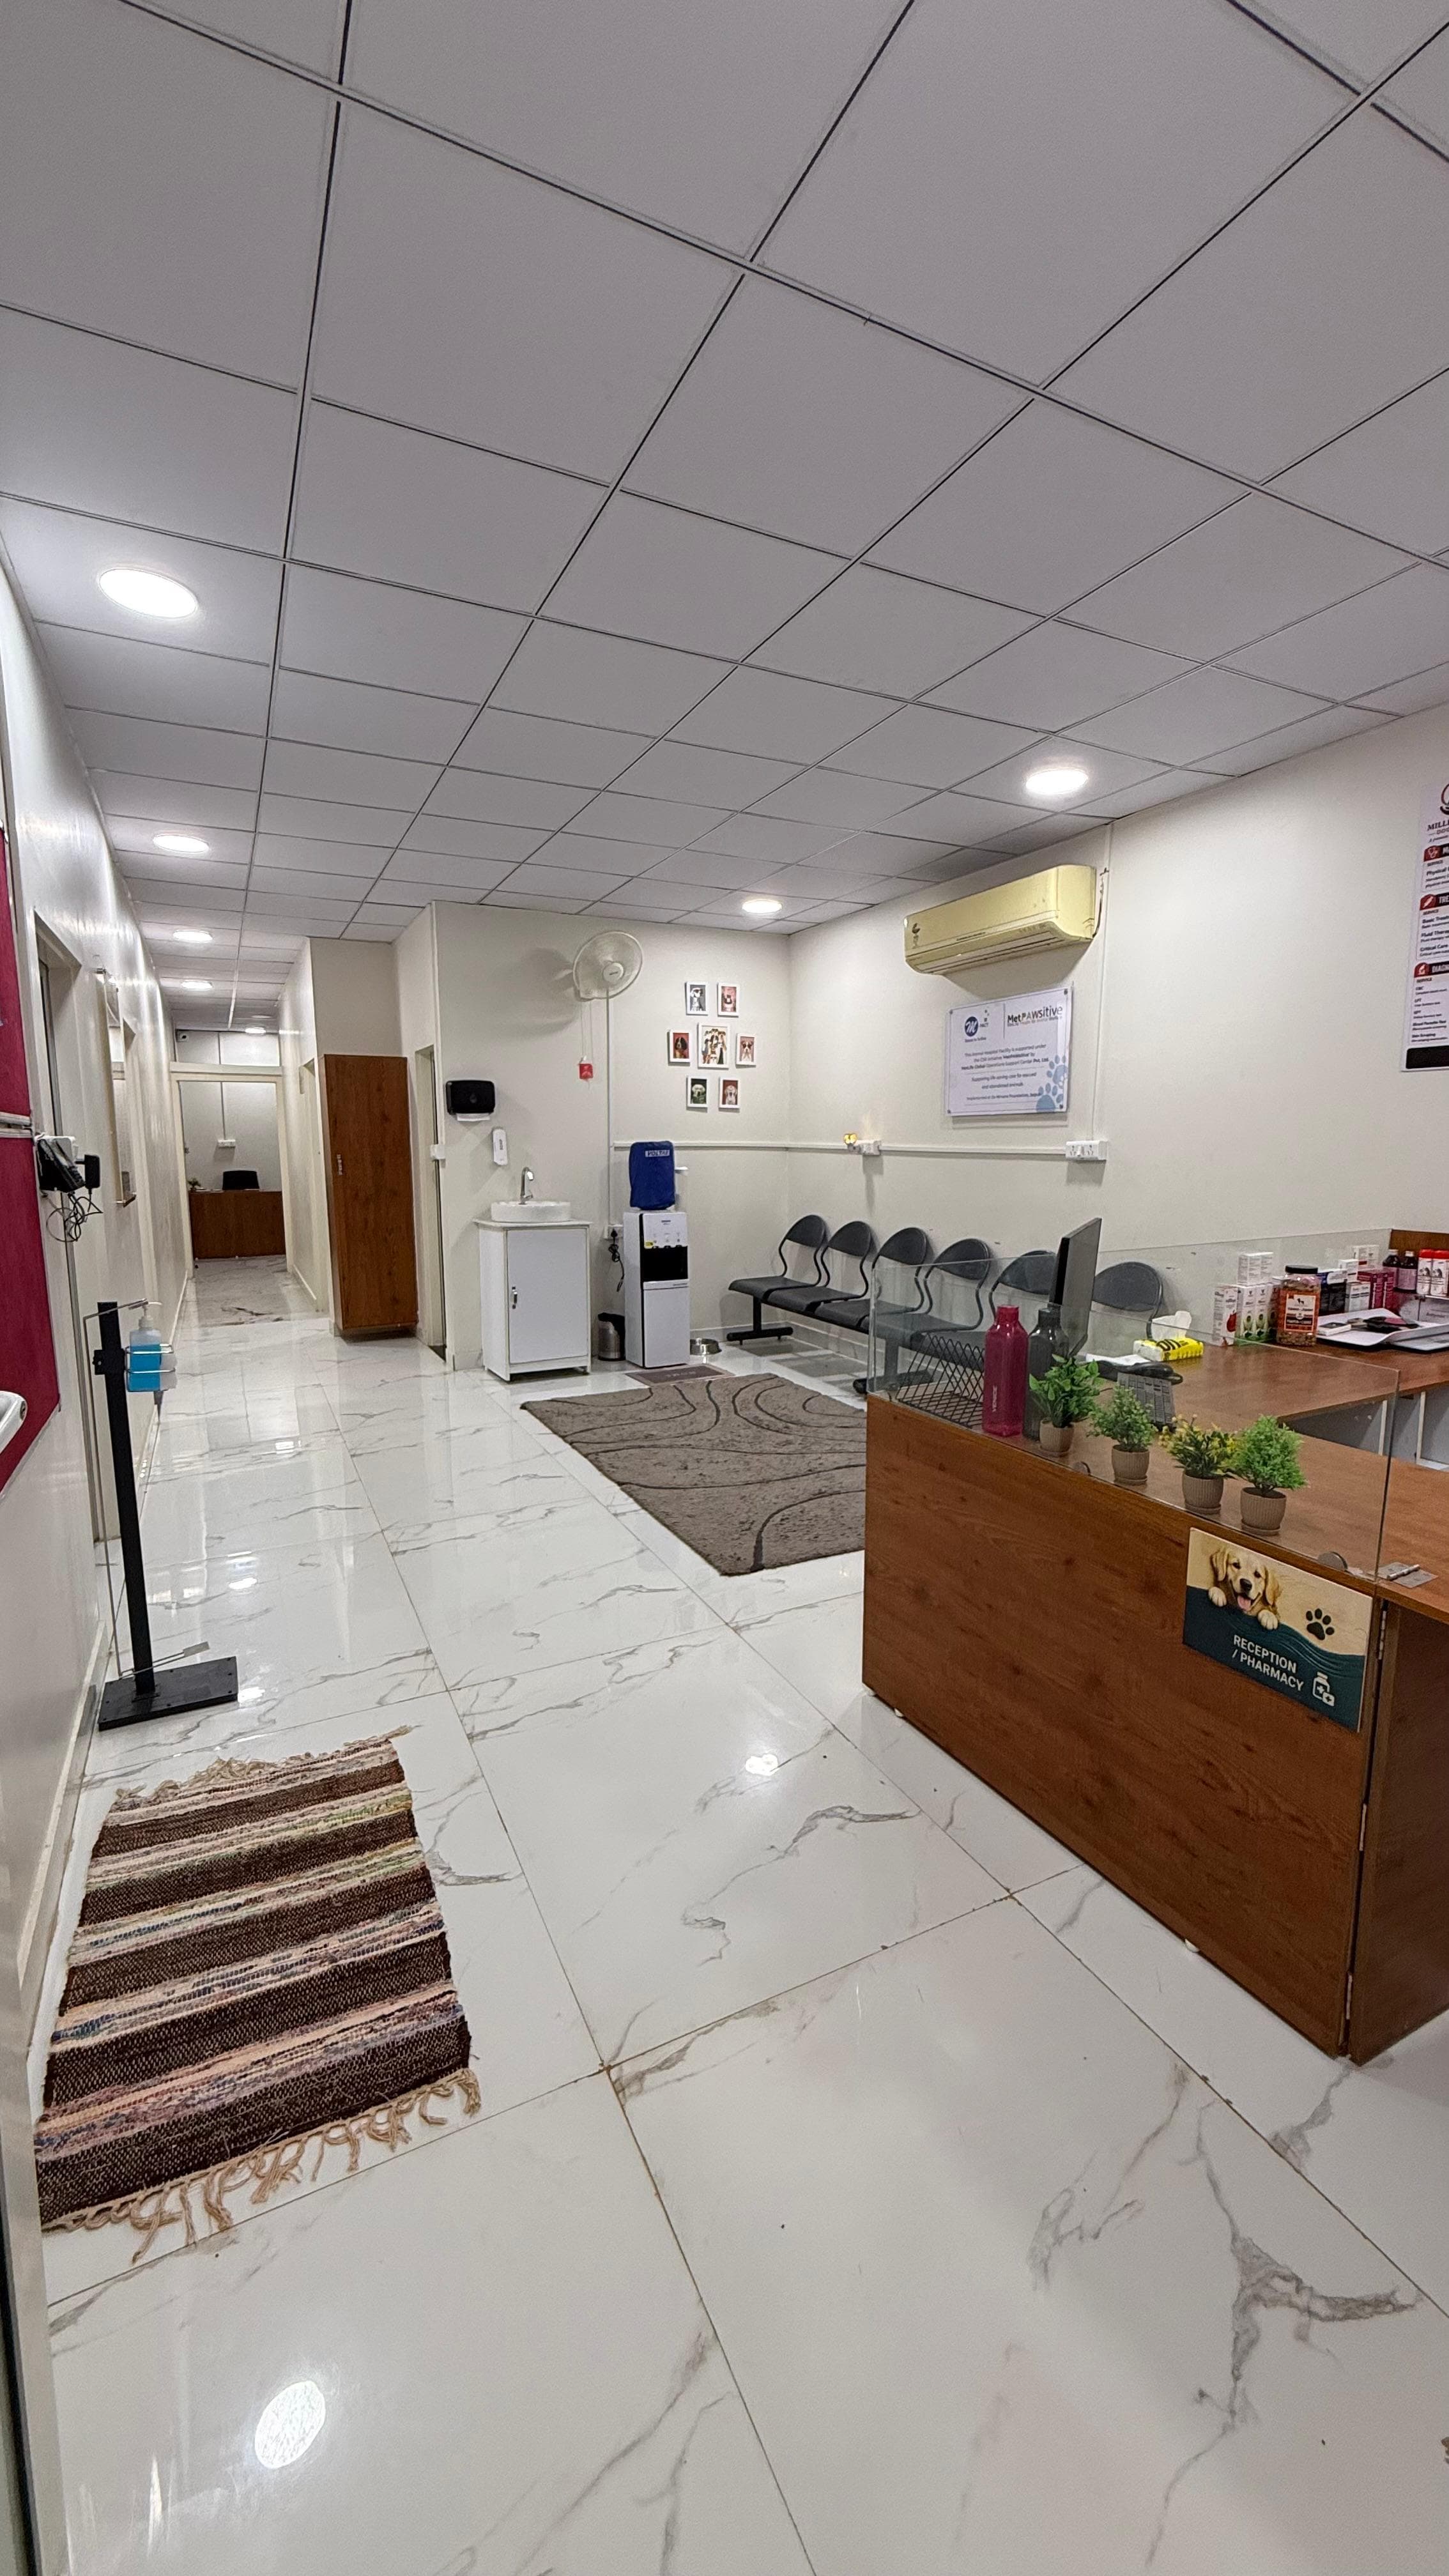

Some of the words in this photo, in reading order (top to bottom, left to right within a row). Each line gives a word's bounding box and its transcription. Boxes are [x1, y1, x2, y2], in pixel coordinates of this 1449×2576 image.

[1427, 820, 1449, 831] MILL
[1007, 1006, 1063, 1023] MetPAWsitive
[1233, 1634, 1297, 1673] RECEPTION
[1240, 1652, 1305, 1692] PHARMACY
